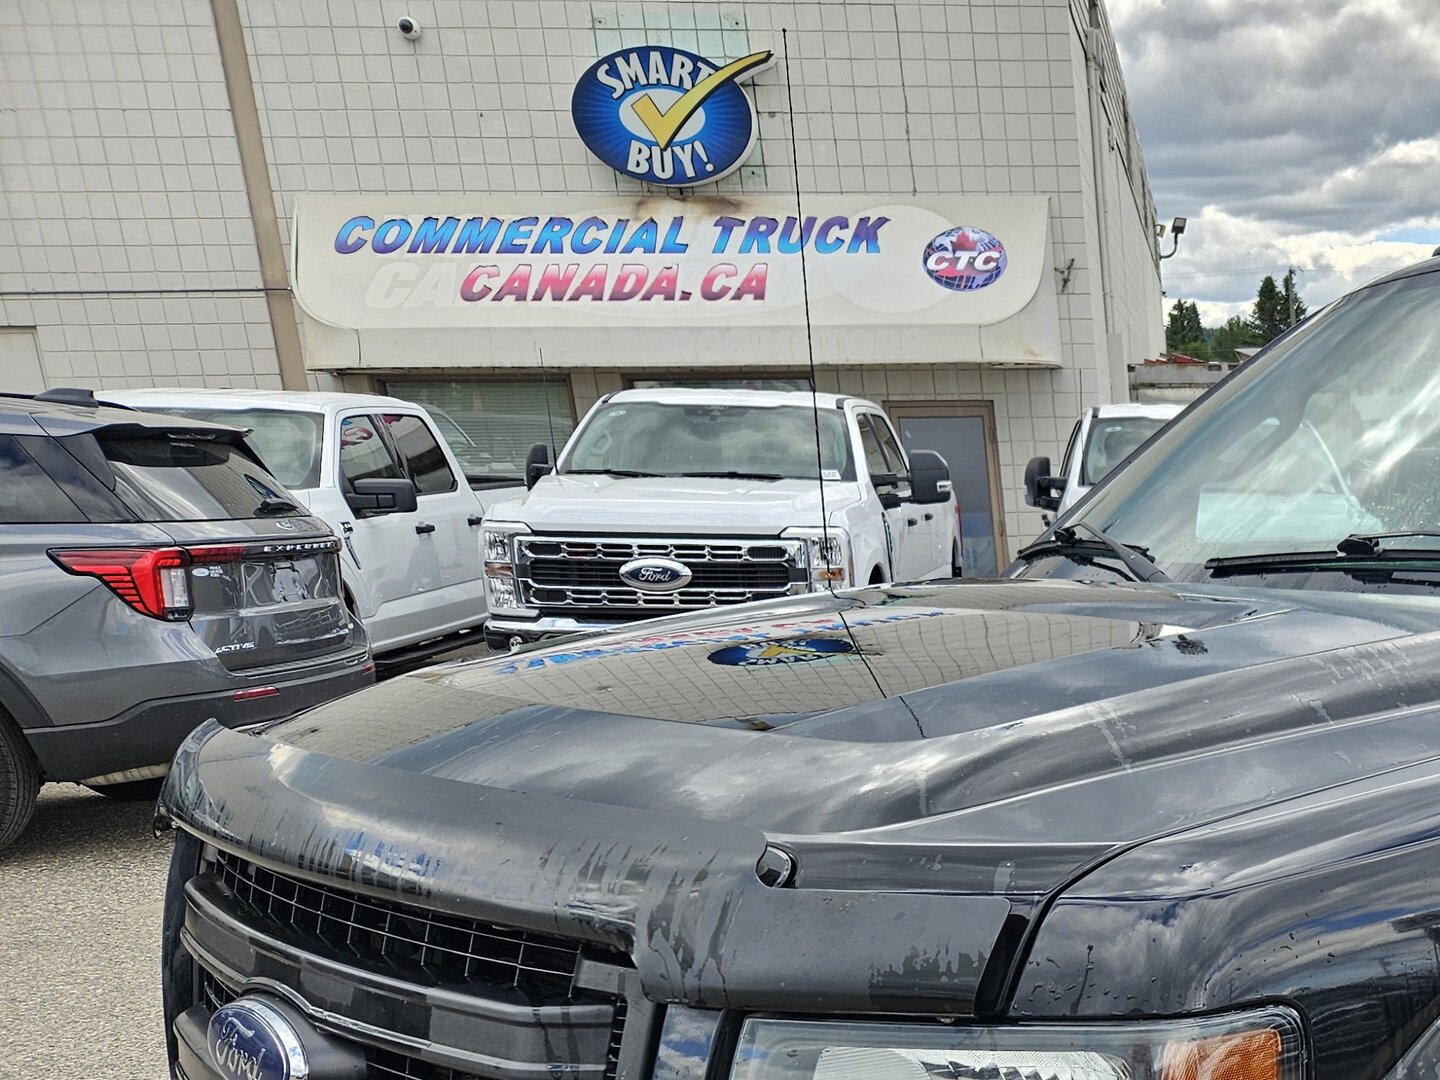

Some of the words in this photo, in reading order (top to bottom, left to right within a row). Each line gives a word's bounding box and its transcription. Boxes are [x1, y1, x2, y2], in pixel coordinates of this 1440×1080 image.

[596, 51, 718, 100] SMART
[627, 140, 717, 180] BUY!
[334, 214, 689, 255] COMMERCIAL
[714, 215, 891, 254] TRUCK
[926, 250, 1001, 272] CTC
[460, 262, 769, 303] CANADA.CA
[639, 567, 672, 582] Ford
